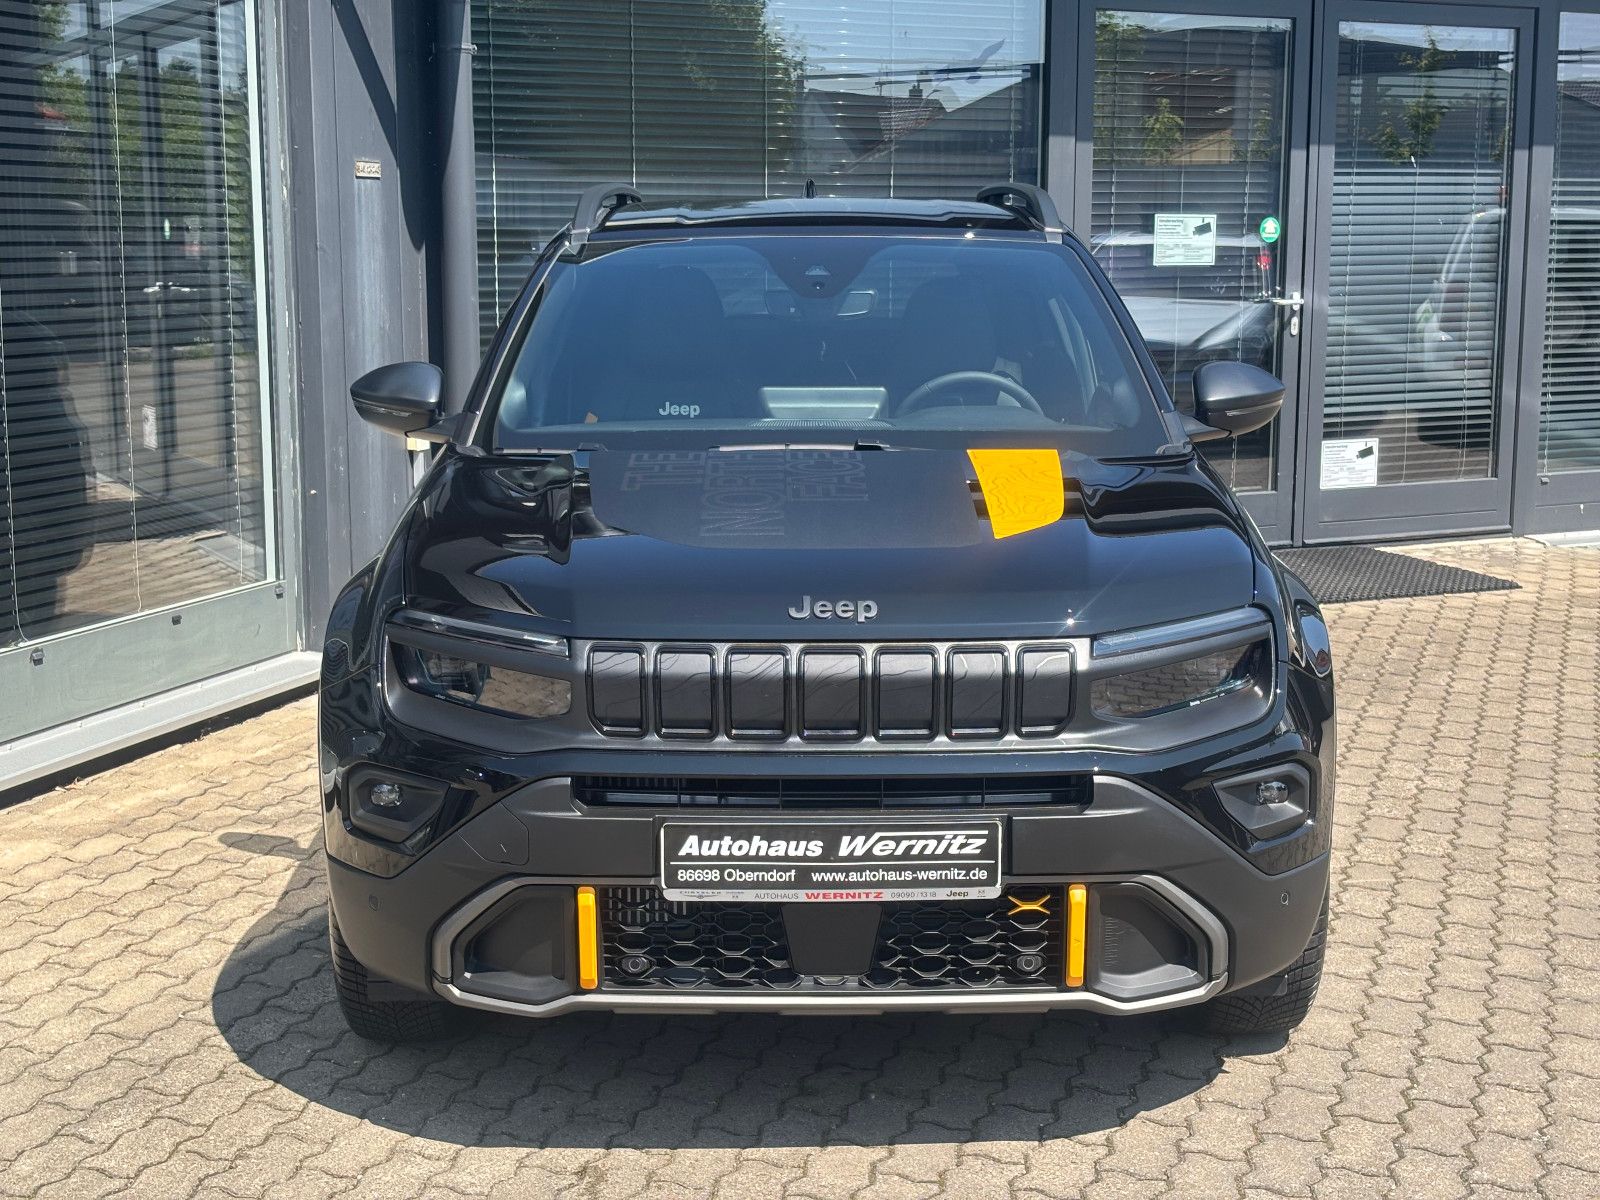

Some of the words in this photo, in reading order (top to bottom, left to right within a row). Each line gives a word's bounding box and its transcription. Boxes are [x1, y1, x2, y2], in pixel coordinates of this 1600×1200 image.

[658, 401, 701, 418] Jeep
[788, 595, 879, 623] Jeep
[678, 834, 823, 857] Autohaus
[838, 830, 989, 857] Wernitz
[677, 869, 720, 882] 86698
[724, 869, 796, 883] Oberndorf
[811, 867, 988, 882] www.autohaus-wernitz.de
[754, 892, 799, 900] AUTOHAUS
[805, 891, 884, 900] WERNITZ
[946, 889, 969, 898] Jeep
